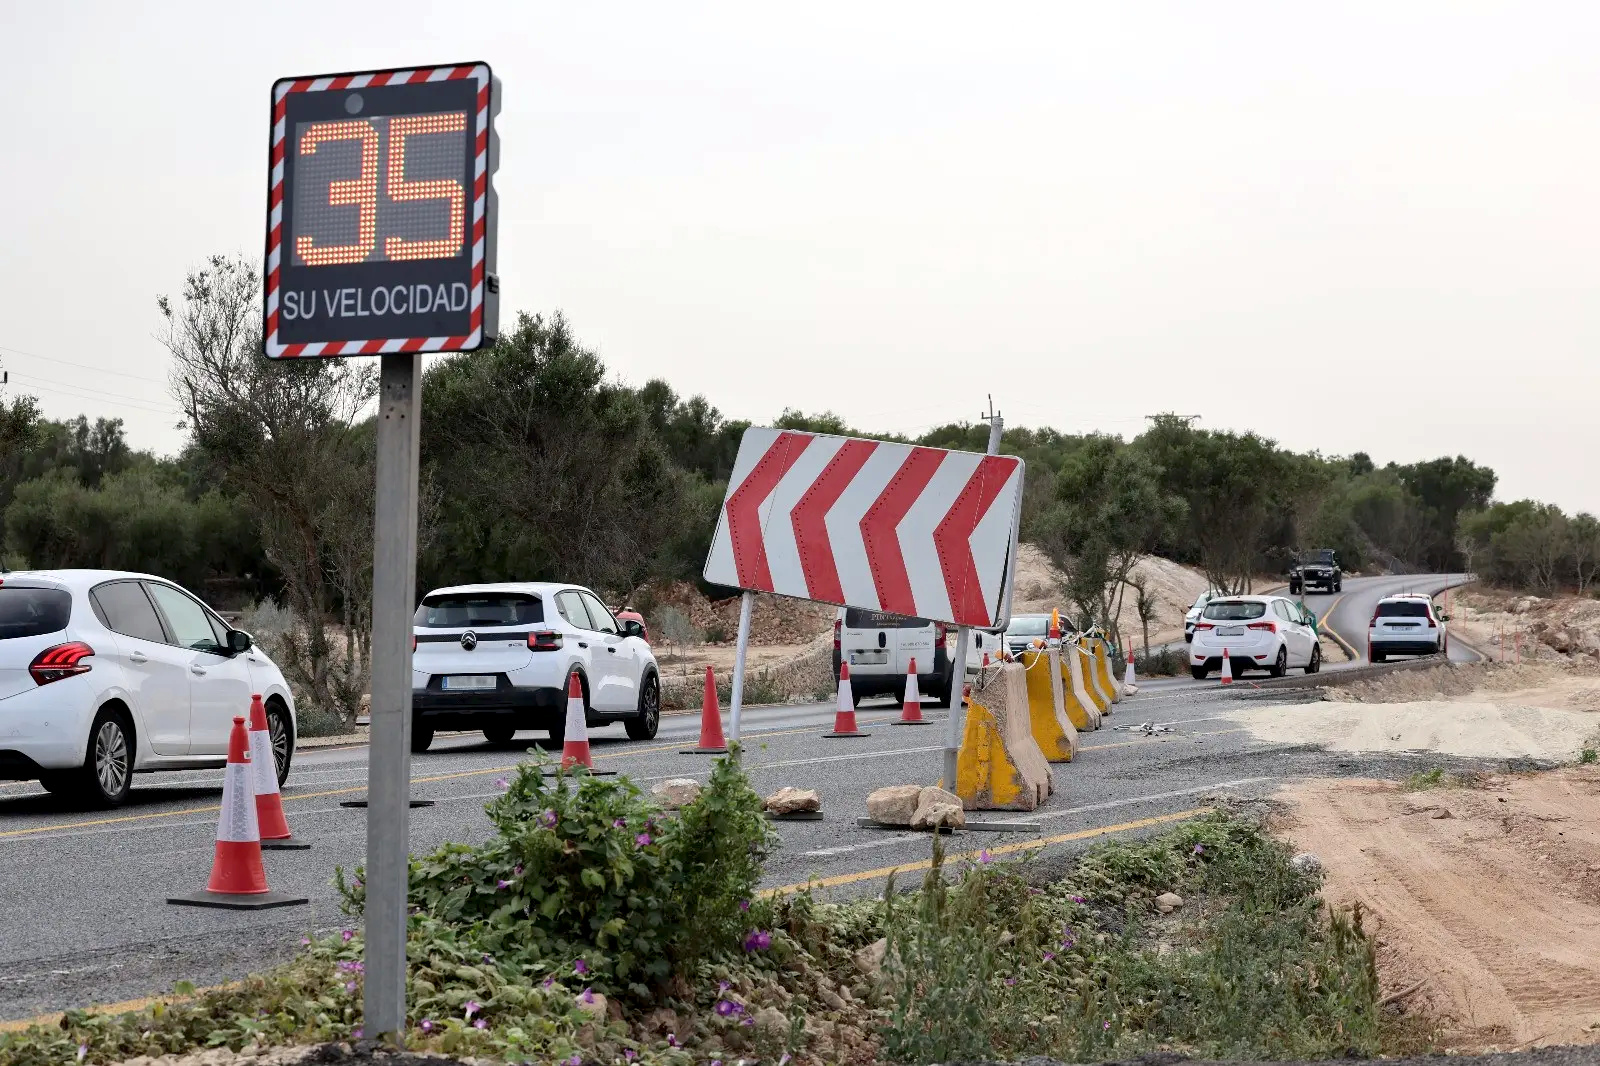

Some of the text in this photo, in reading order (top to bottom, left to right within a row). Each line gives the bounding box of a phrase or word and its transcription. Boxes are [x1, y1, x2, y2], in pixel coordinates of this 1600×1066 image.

[297, 112, 467, 266] 35
[283, 282, 468, 320] SU VELOCIDAD
